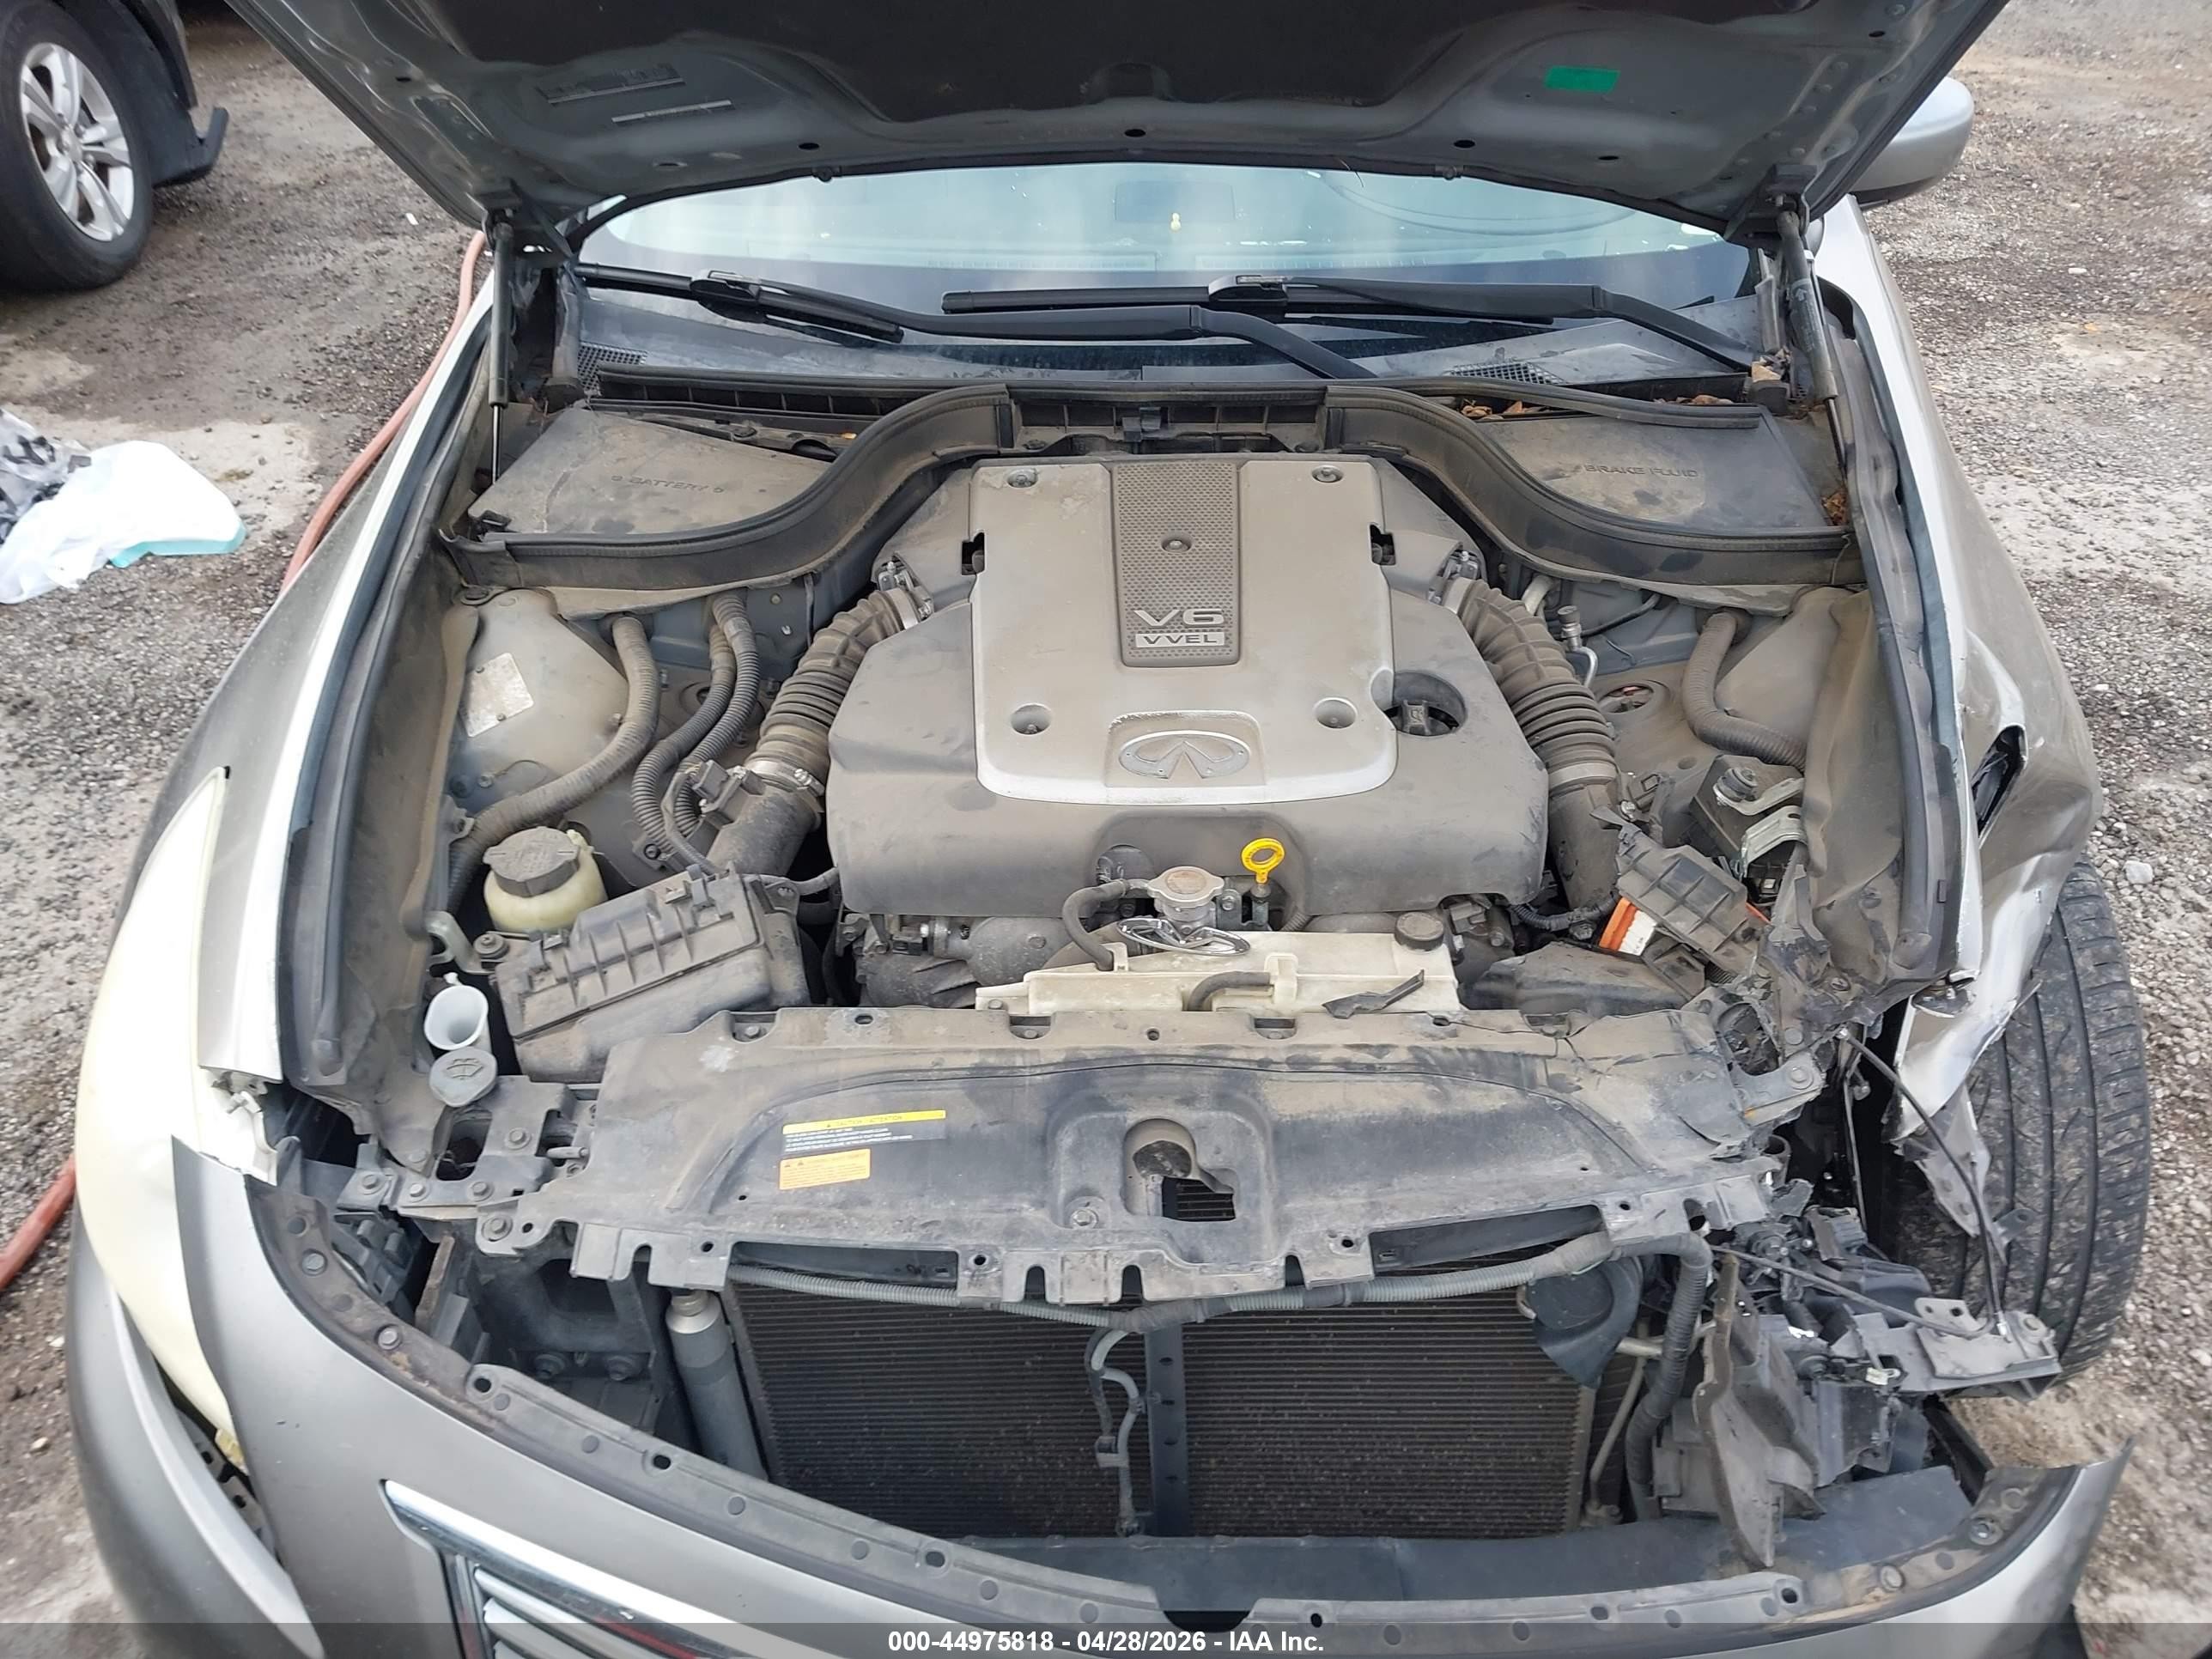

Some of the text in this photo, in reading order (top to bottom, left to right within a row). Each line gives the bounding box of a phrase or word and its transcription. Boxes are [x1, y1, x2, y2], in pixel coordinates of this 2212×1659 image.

[1583, 464, 1698, 477] BRAKE FLUID
[629, 477, 709, 491] BATTERY
[1133, 608, 1224, 627] V6
[1145, 635, 1217, 644] VVEL
